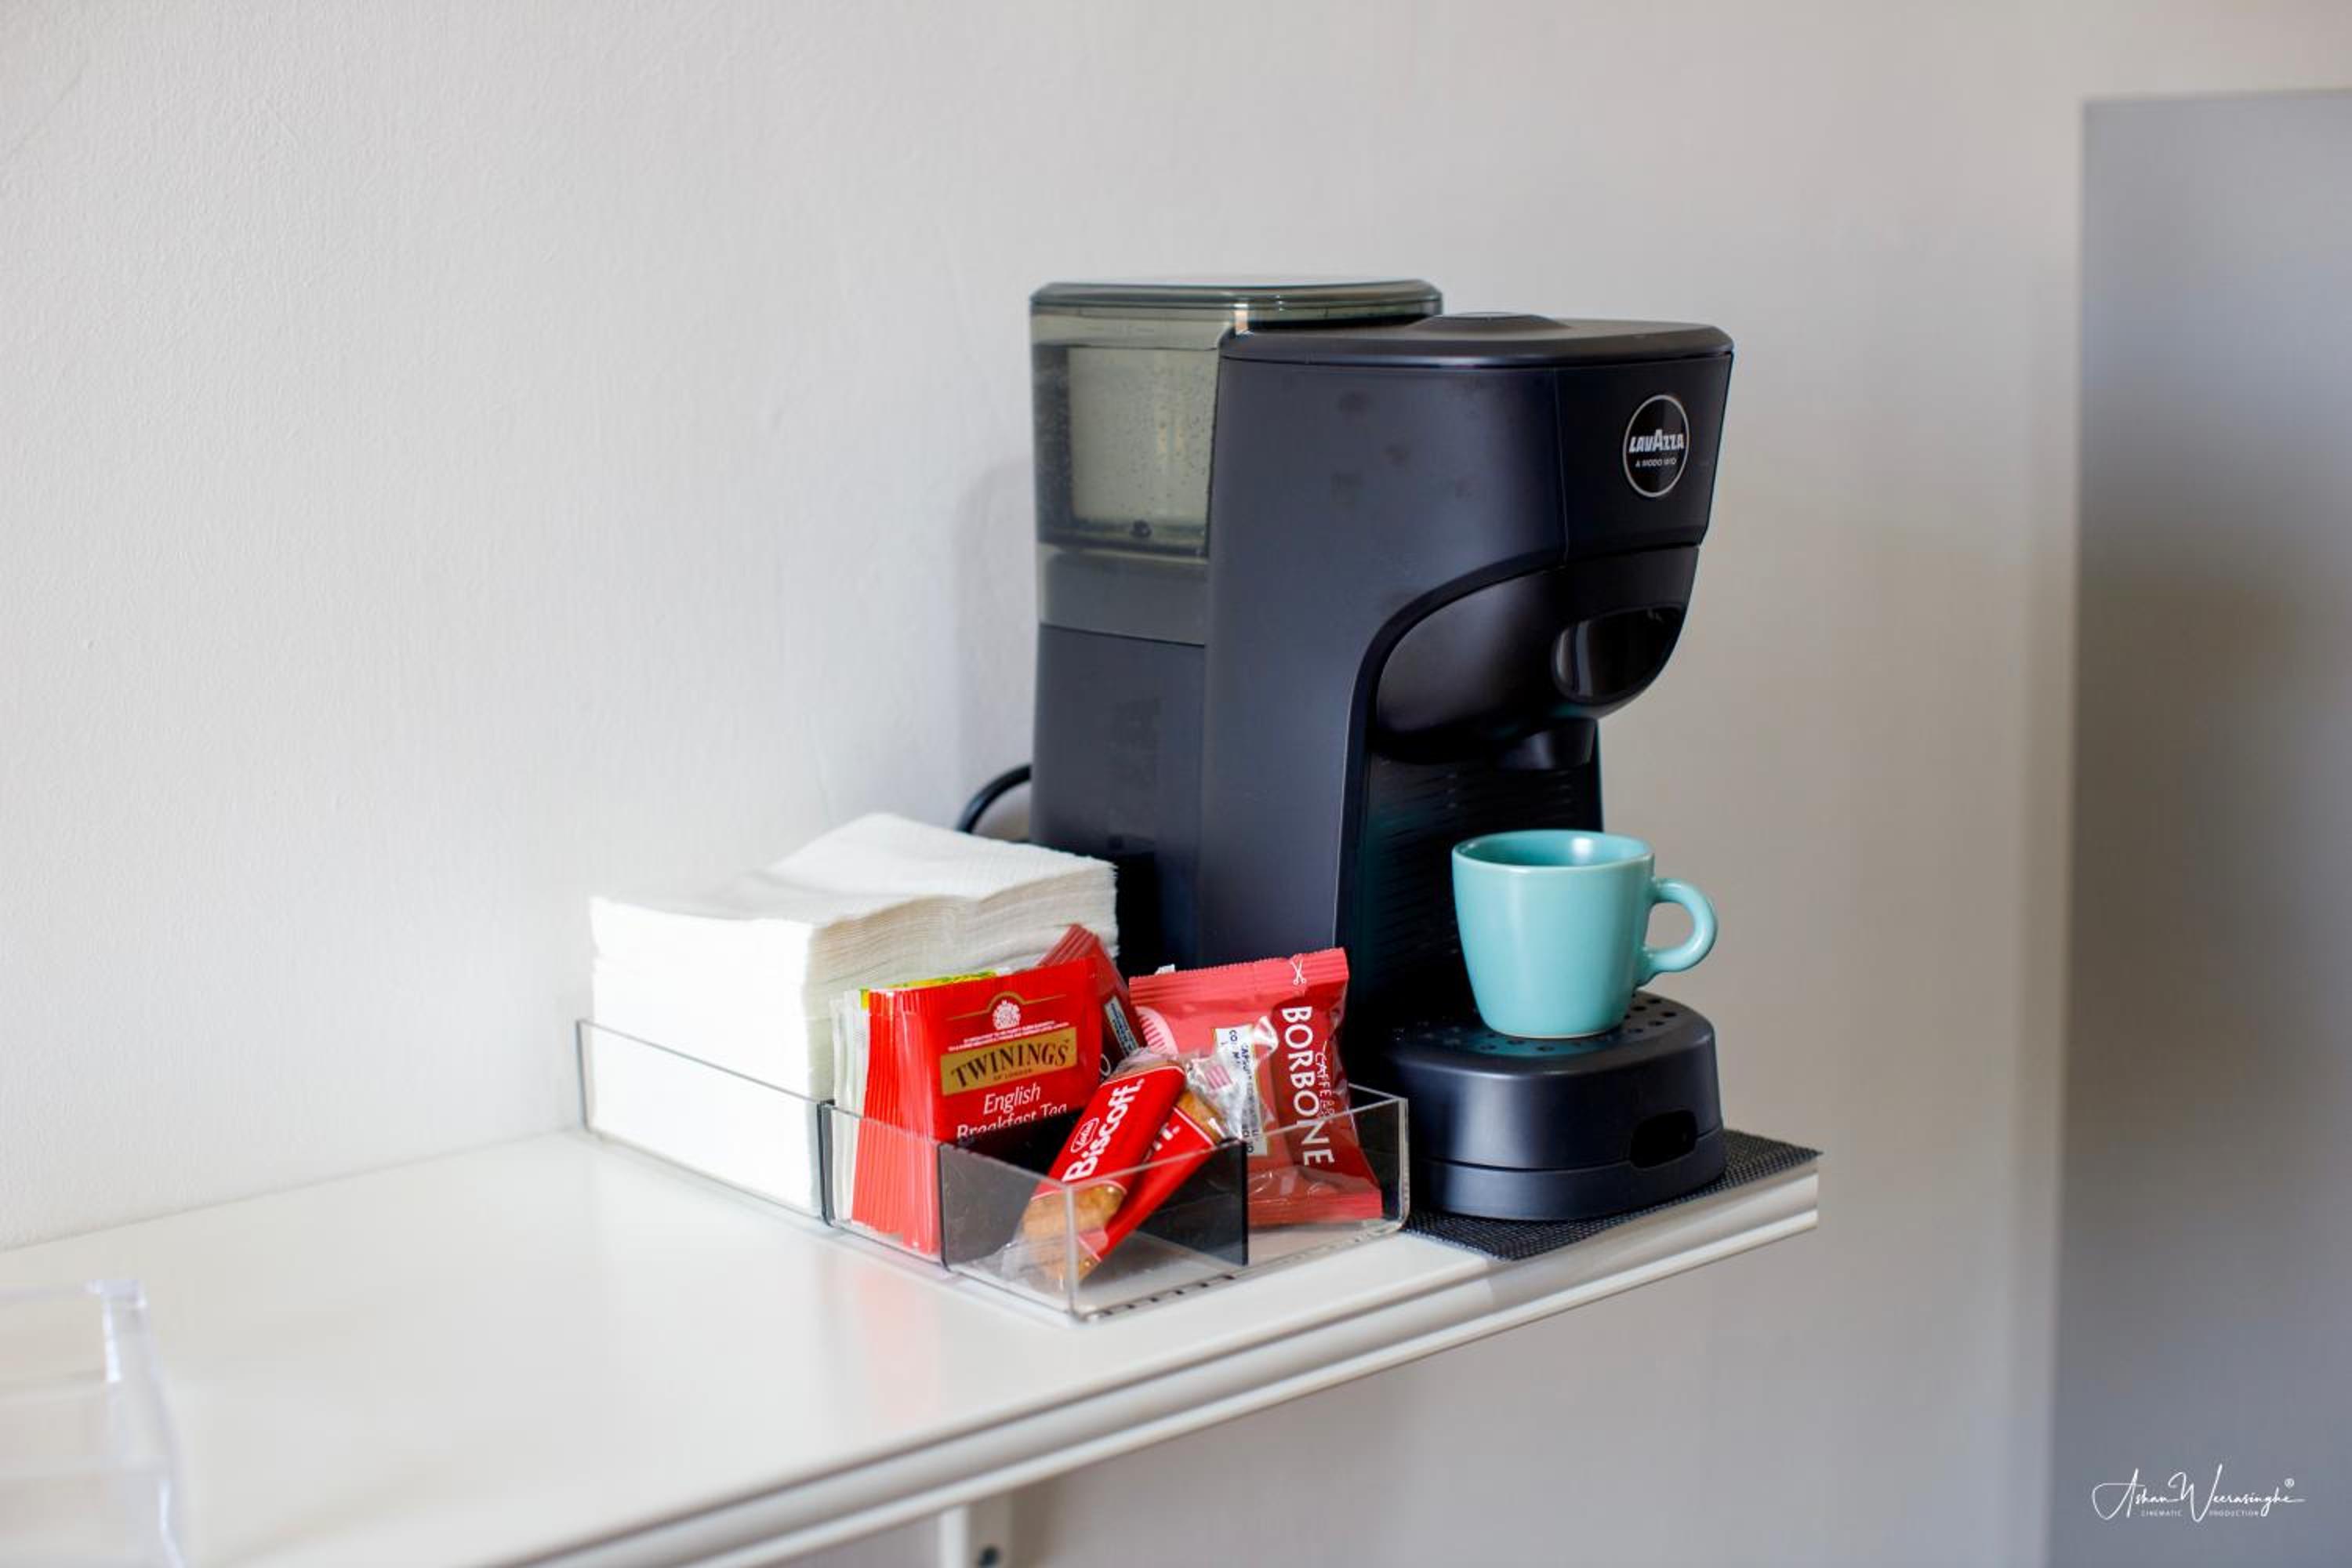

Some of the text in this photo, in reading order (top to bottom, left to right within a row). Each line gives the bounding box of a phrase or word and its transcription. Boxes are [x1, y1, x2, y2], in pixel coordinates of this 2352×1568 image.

[1628, 429, 1684, 452] LAVAZZA
[950, 1042, 1070, 1088] TWININGS
[1281, 1006, 1335, 1167] BORBONE
[983, 1081, 1041, 1115] English
[1062, 1084, 1142, 1181] Biscoff
